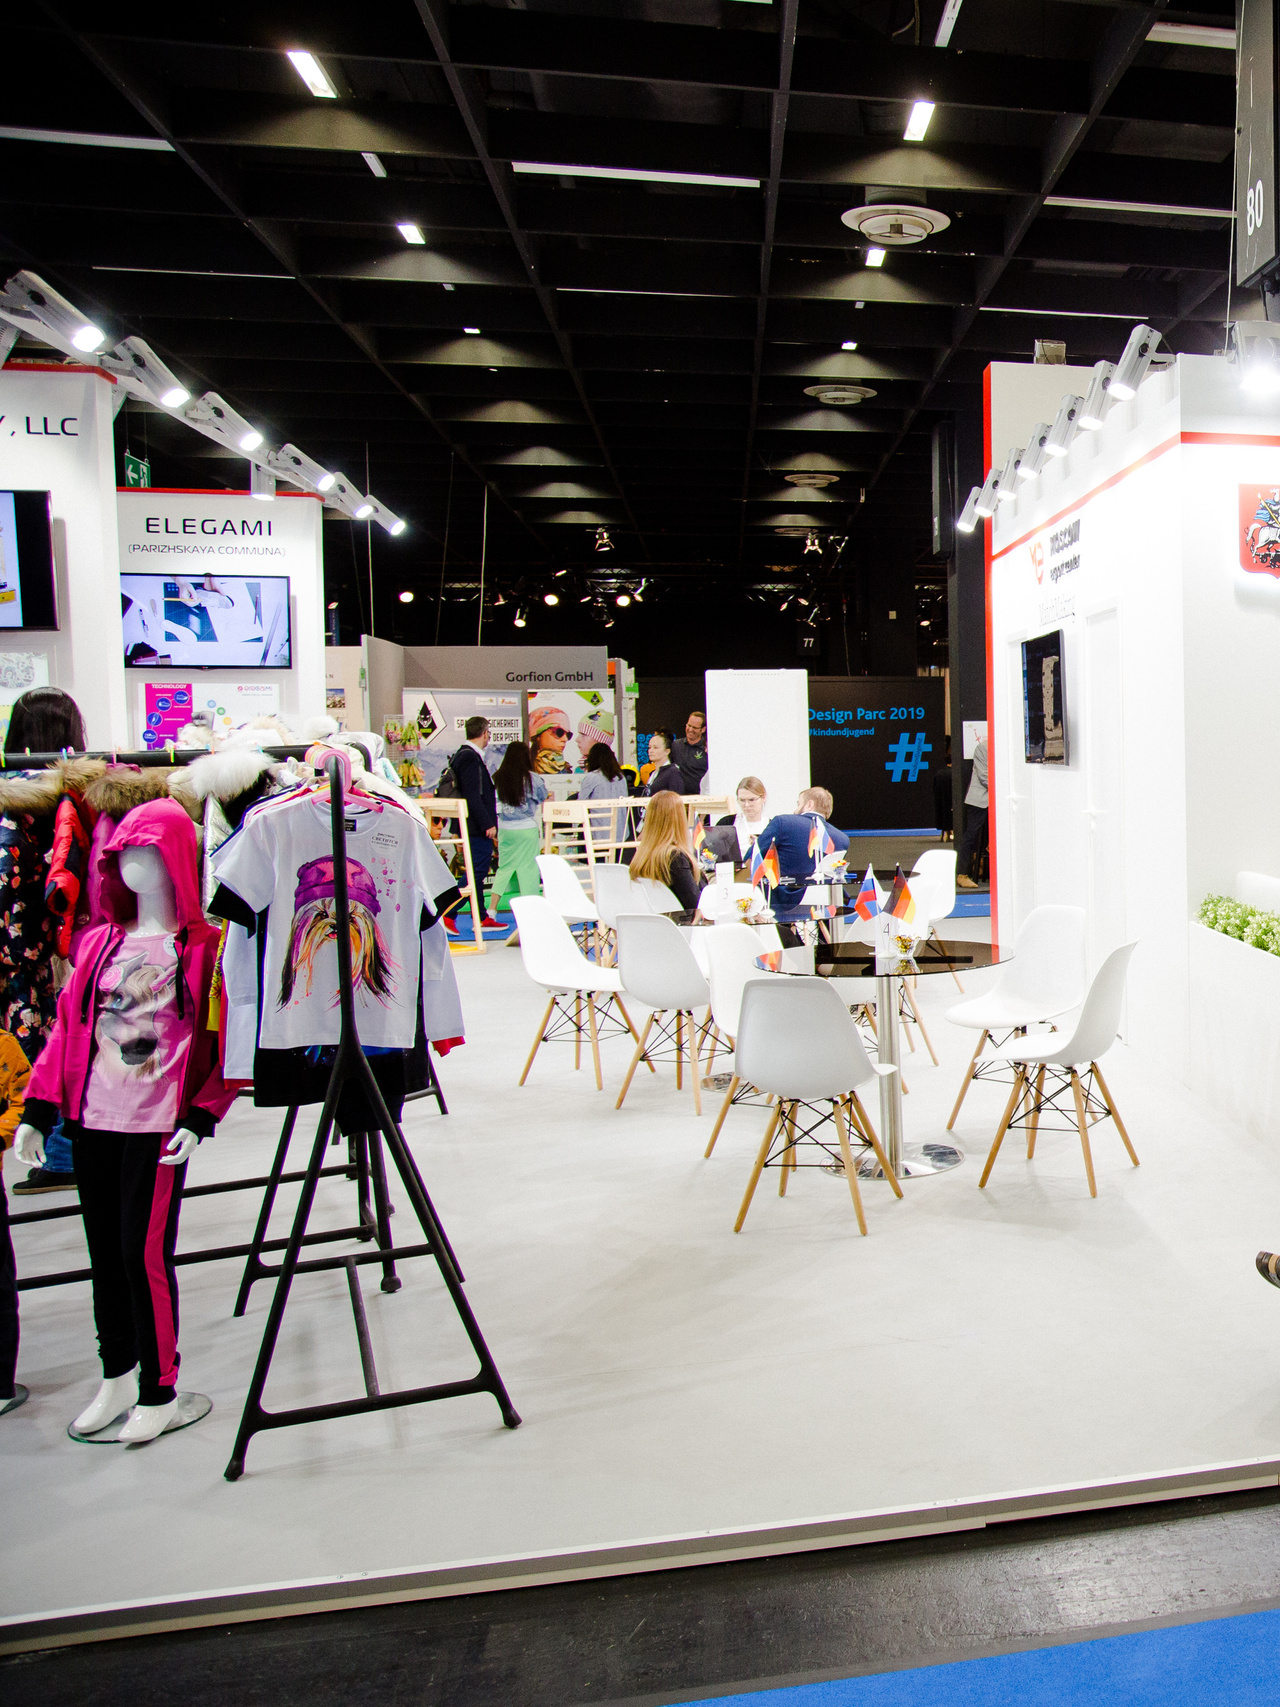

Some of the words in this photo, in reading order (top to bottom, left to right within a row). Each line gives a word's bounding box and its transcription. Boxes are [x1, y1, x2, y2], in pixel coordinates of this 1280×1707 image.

[1247, 179, 1263, 236] 80
[25, 416, 78, 436] LLC
[146, 517, 272, 536] ELEGAMI
[128, 544, 215, 554] (PARIZHSKAYA
[218, 546, 285, 557] COMMUNA)
[803, 638, 814, 647] 77
[505, 671, 552, 682] Gorfion
[554, 671, 593, 681] GmbH
[808, 708, 853, 724] Design
[857, 708, 886, 720] Parc
[889, 707, 925, 720] 2019
[493, 733, 503, 741] DER
[505, 733, 519, 742] PISTE
[883, 922, 890, 937] 4
